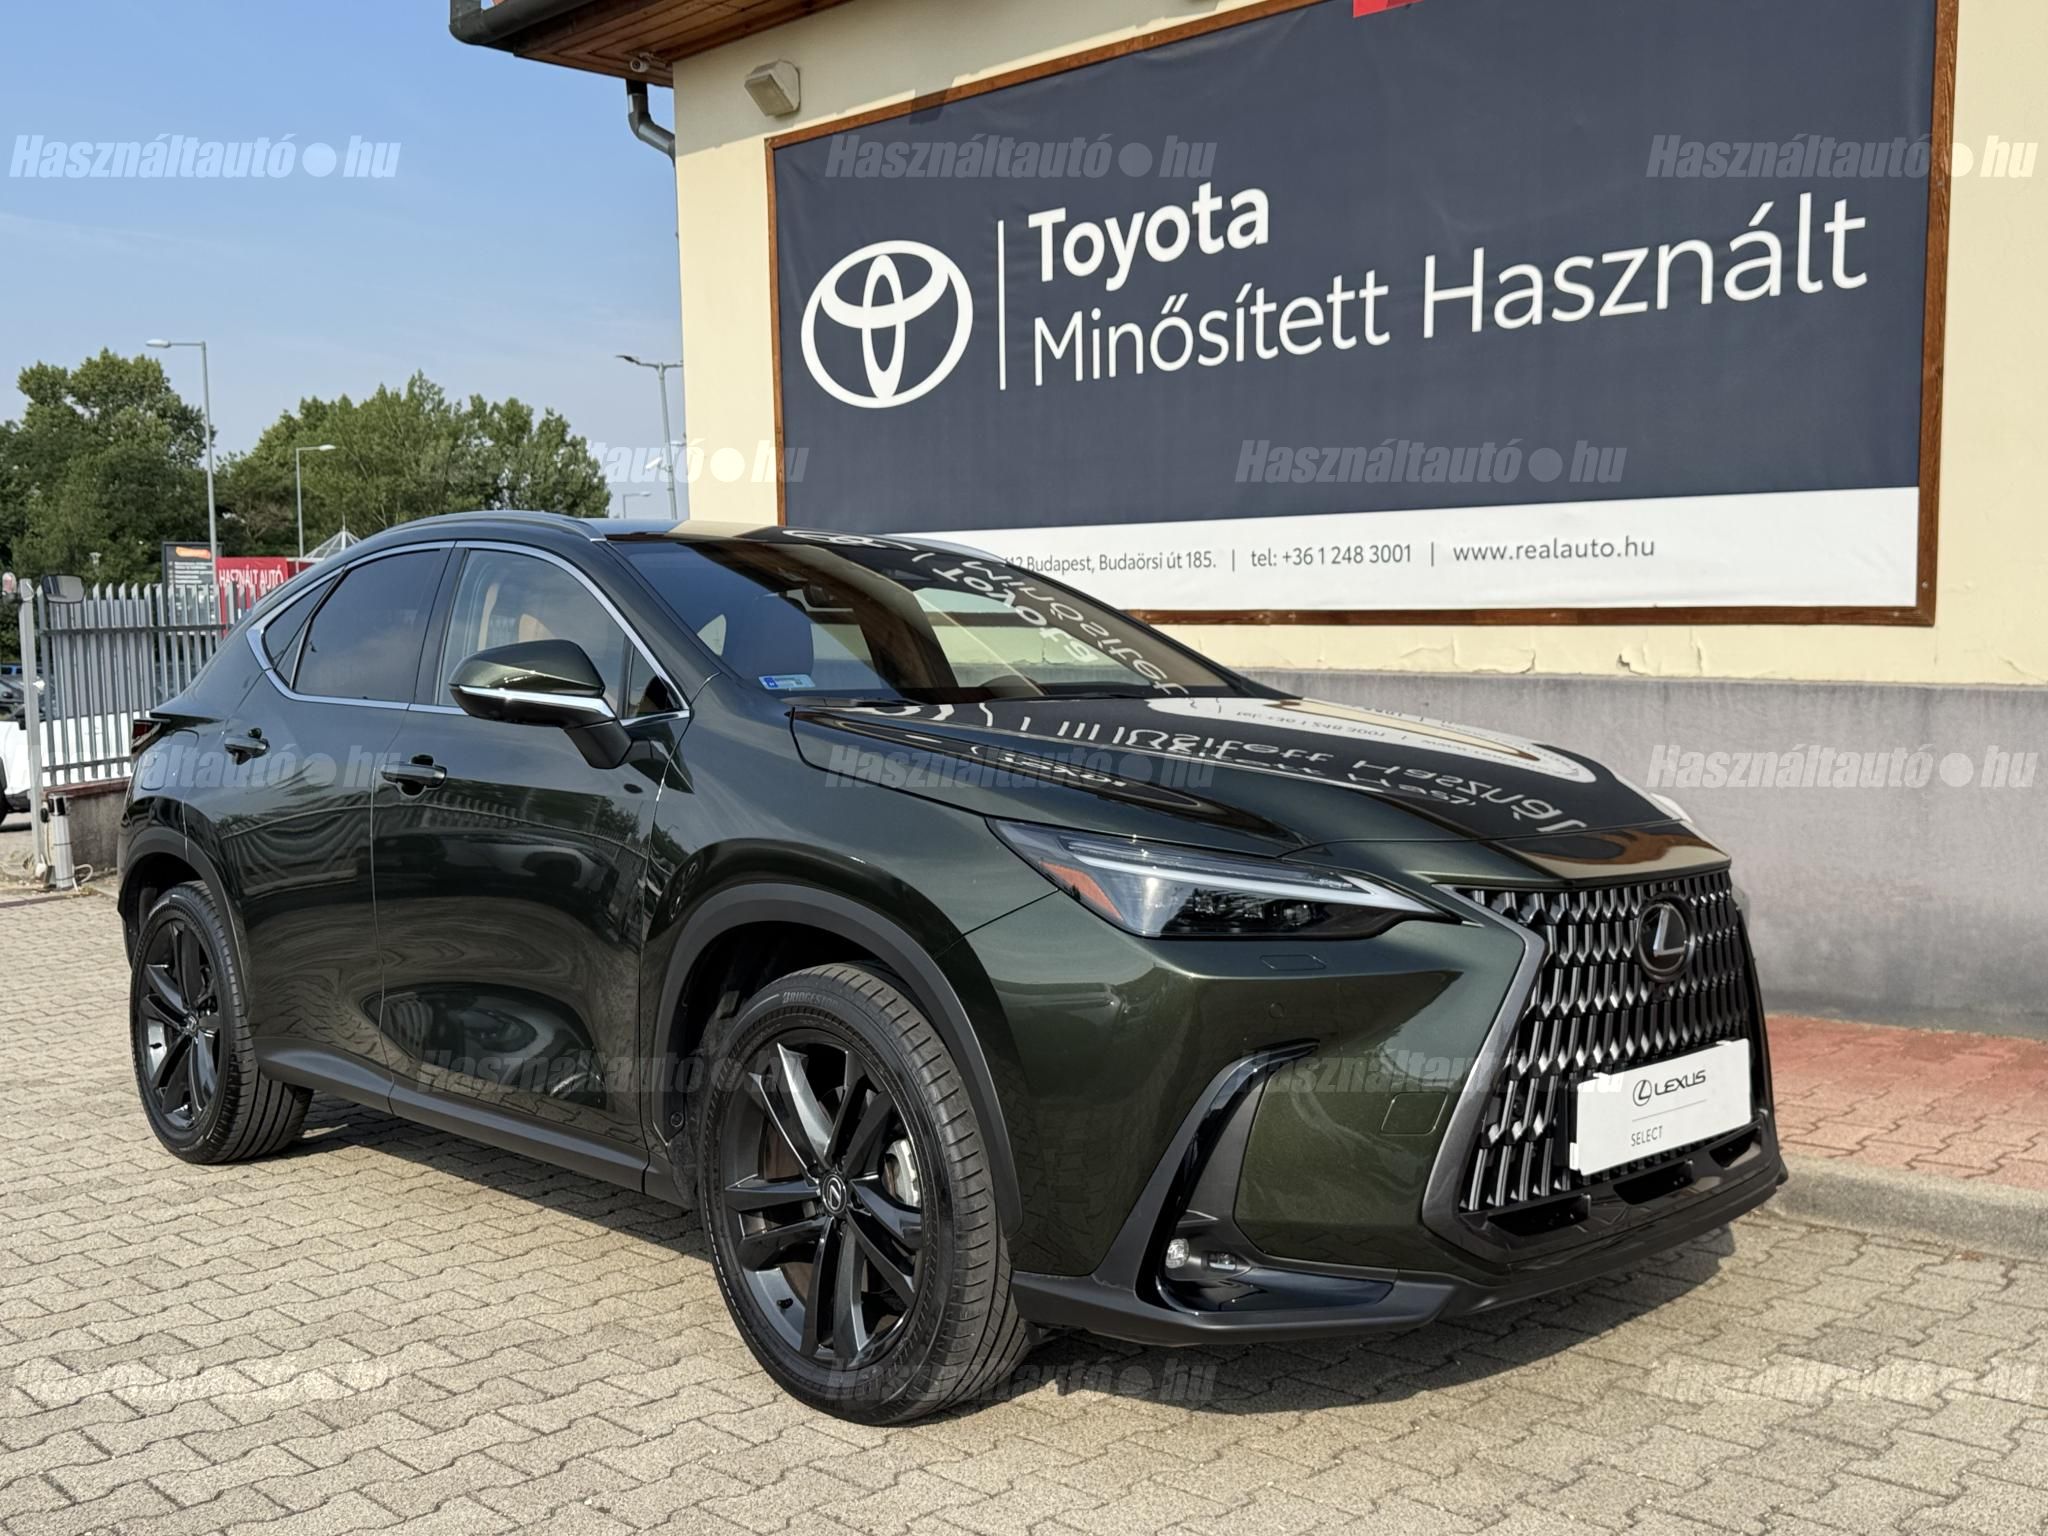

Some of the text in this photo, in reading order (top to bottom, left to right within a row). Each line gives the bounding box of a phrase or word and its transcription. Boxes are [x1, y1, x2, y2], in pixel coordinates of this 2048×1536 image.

[1028, 182, 1269, 292] Toyota
[1033, 192, 1867, 387] Minősített Használt
[1027, 554, 1095, 576] Budapest,
[1099, 552, 1163, 572] Budaörsi
[1166, 551, 1184, 570] út
[1186, 550, 1217, 569] 185.
[1251, 547, 1277, 567] tel:
[1331, 545, 1364, 565] 248
[1369, 543, 1412, 565] 3001
[1453, 535, 1656, 561] www.realauto.hu
[1654, 1069, 1706, 1096] LEXUS
[1630, 1125, 1663, 1147] SELECT
